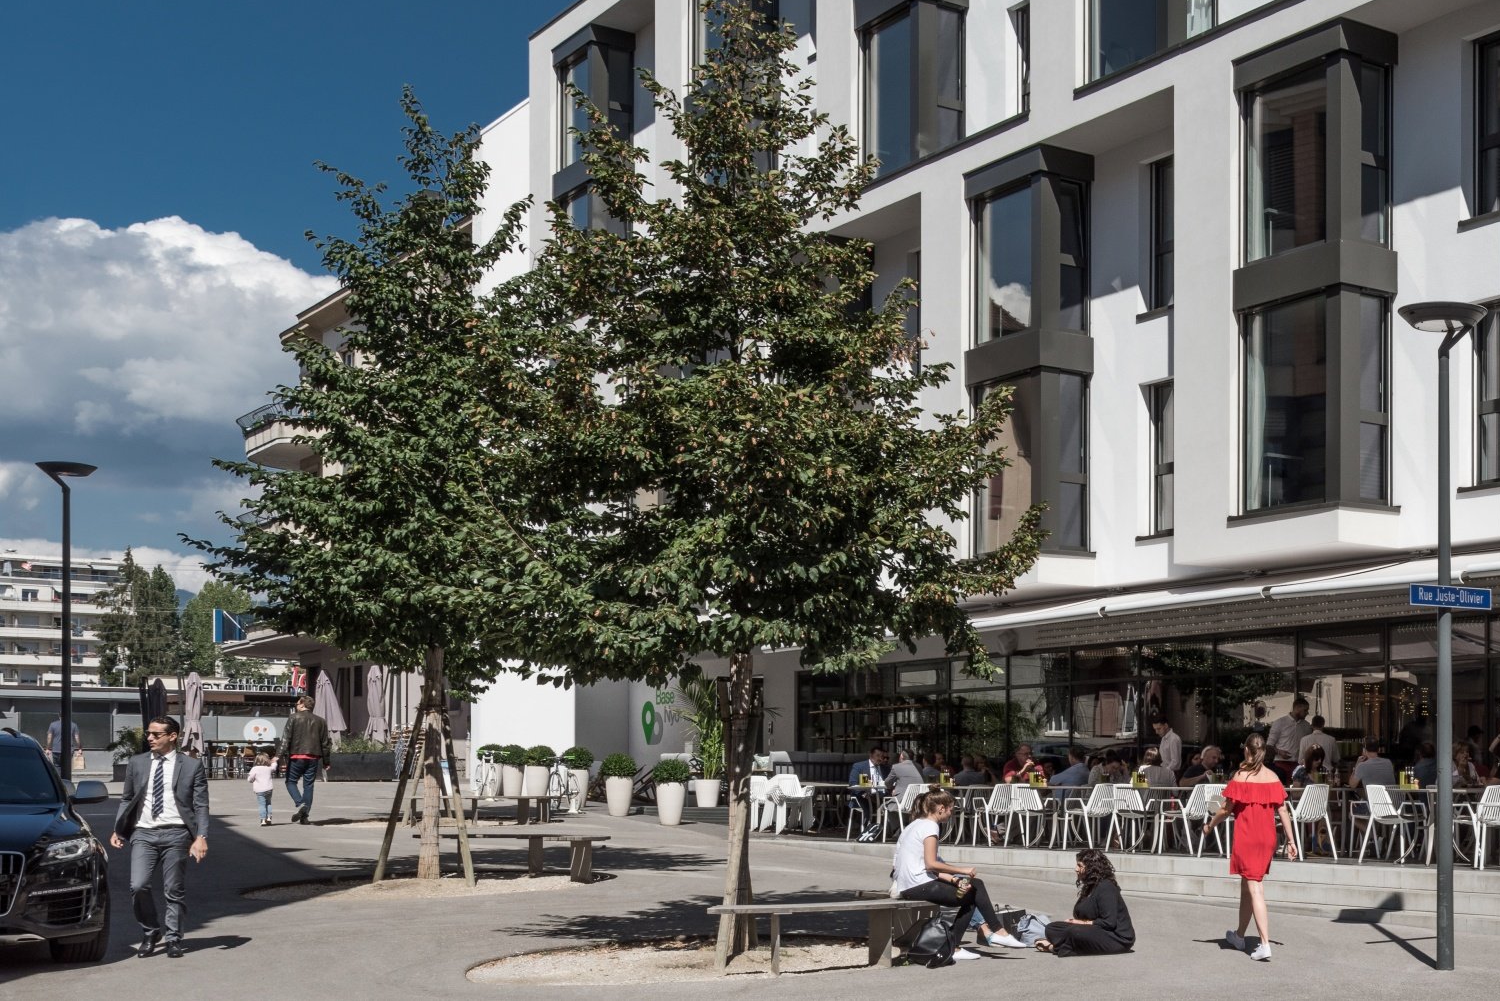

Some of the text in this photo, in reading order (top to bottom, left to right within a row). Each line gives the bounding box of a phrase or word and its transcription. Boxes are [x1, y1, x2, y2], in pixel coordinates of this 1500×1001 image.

[1418, 586, 1485, 604] Rue Juste-Olivier
[655, 688, 675, 705] Base
[663, 706, 680, 726] Nyo
